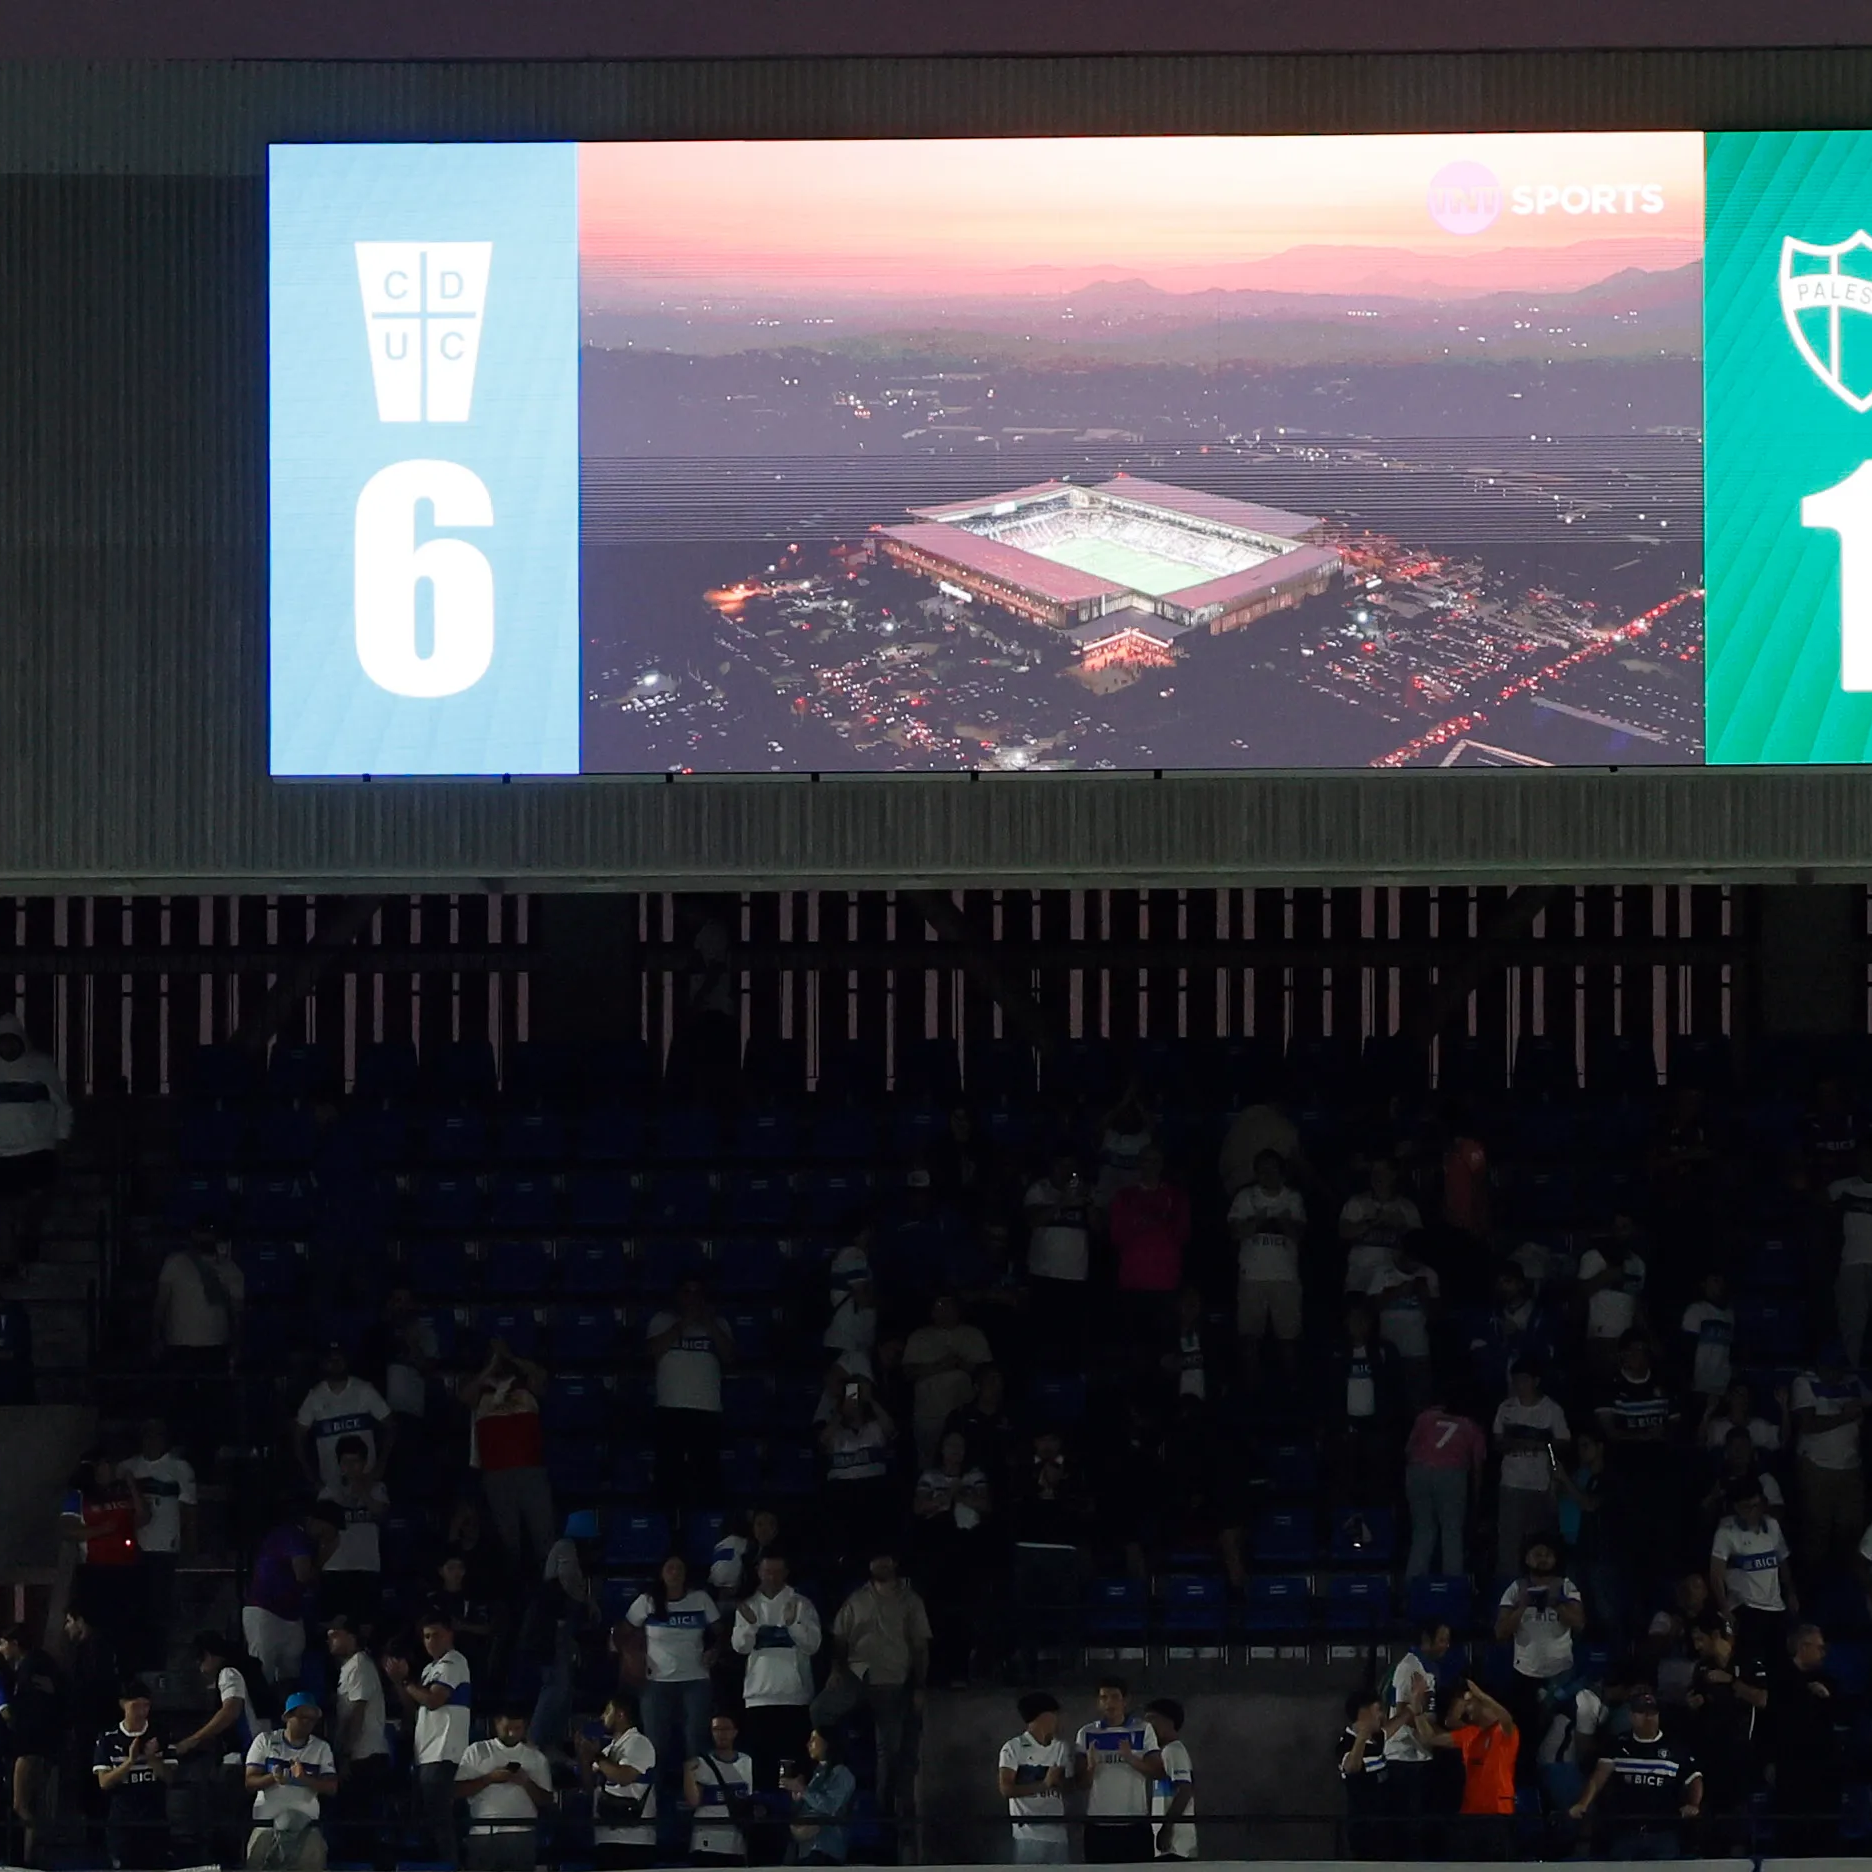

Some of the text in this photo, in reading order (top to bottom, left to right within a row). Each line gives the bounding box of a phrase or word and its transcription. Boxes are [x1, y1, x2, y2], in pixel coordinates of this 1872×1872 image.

[1511, 184, 1664, 214] SPORTS
[383, 270, 465, 300] C D
[384, 331, 465, 361] U C
[354, 458, 494, 698] 6
[1436, 1422, 1459, 1448] 7
[1634, 1774, 1663, 1788] BICE
